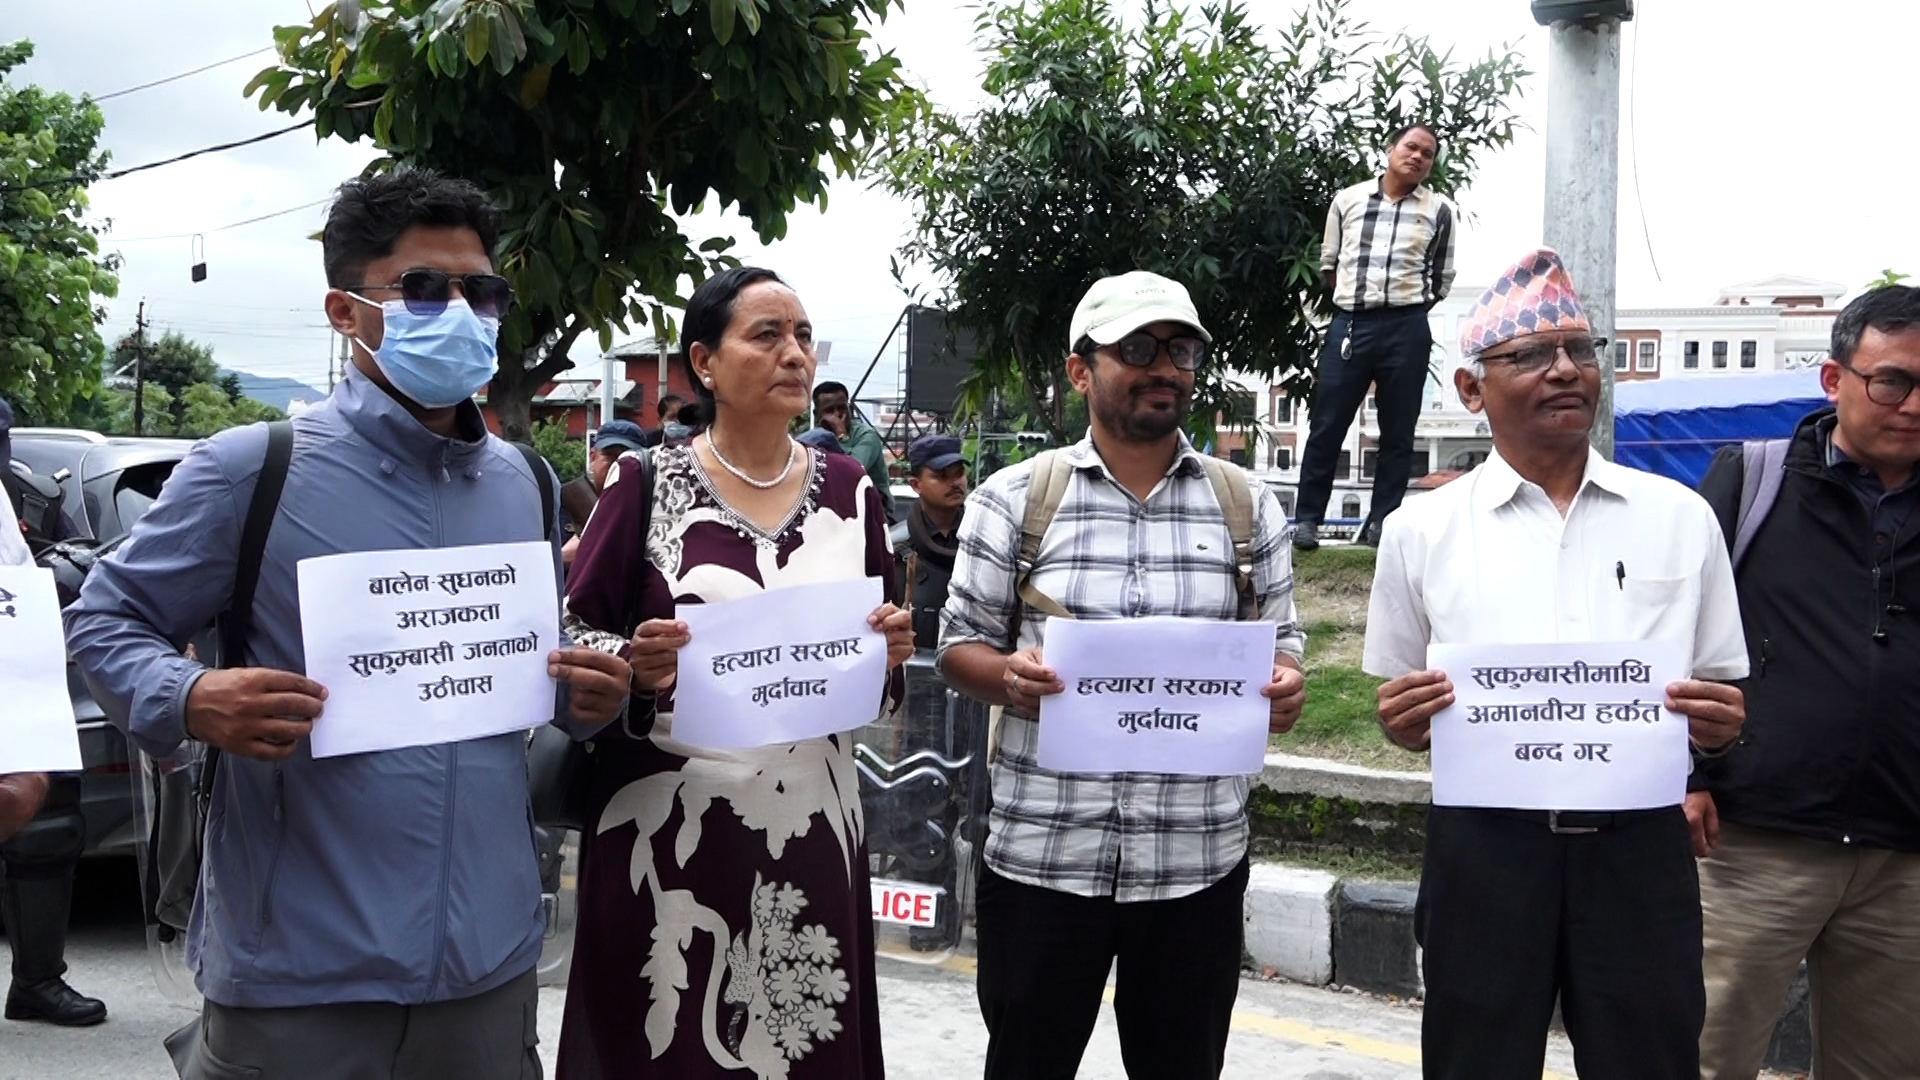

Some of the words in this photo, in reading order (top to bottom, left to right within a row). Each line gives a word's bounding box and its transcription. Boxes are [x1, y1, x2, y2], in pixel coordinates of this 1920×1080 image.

[396, 603, 500, 629] अराजकता
[348, 641, 454, 678] सुकुम्बासी
[462, 631, 539, 660] जनताको
[711, 645, 782, 676] हत्यारा
[790, 637, 862, 662] सरकार
[417, 675, 493, 701] उठीवास
[1076, 676, 1156, 696] हत्यारा
[1162, 677, 1247, 697] सरकार
[1471, 659, 1652, 690] सुकुम्बासीमाथि
[752, 675, 829, 707] मुर्दावाद
[1117, 707, 1201, 734] मुर्दावाद
[1466, 697, 1587, 724] अमानवीय
[1595, 699, 1662, 724] हर्कत
[1514, 743, 1564, 762] बन्द
[1573, 743, 1613, 763] गर
[872, 890, 932, 923] ICE
